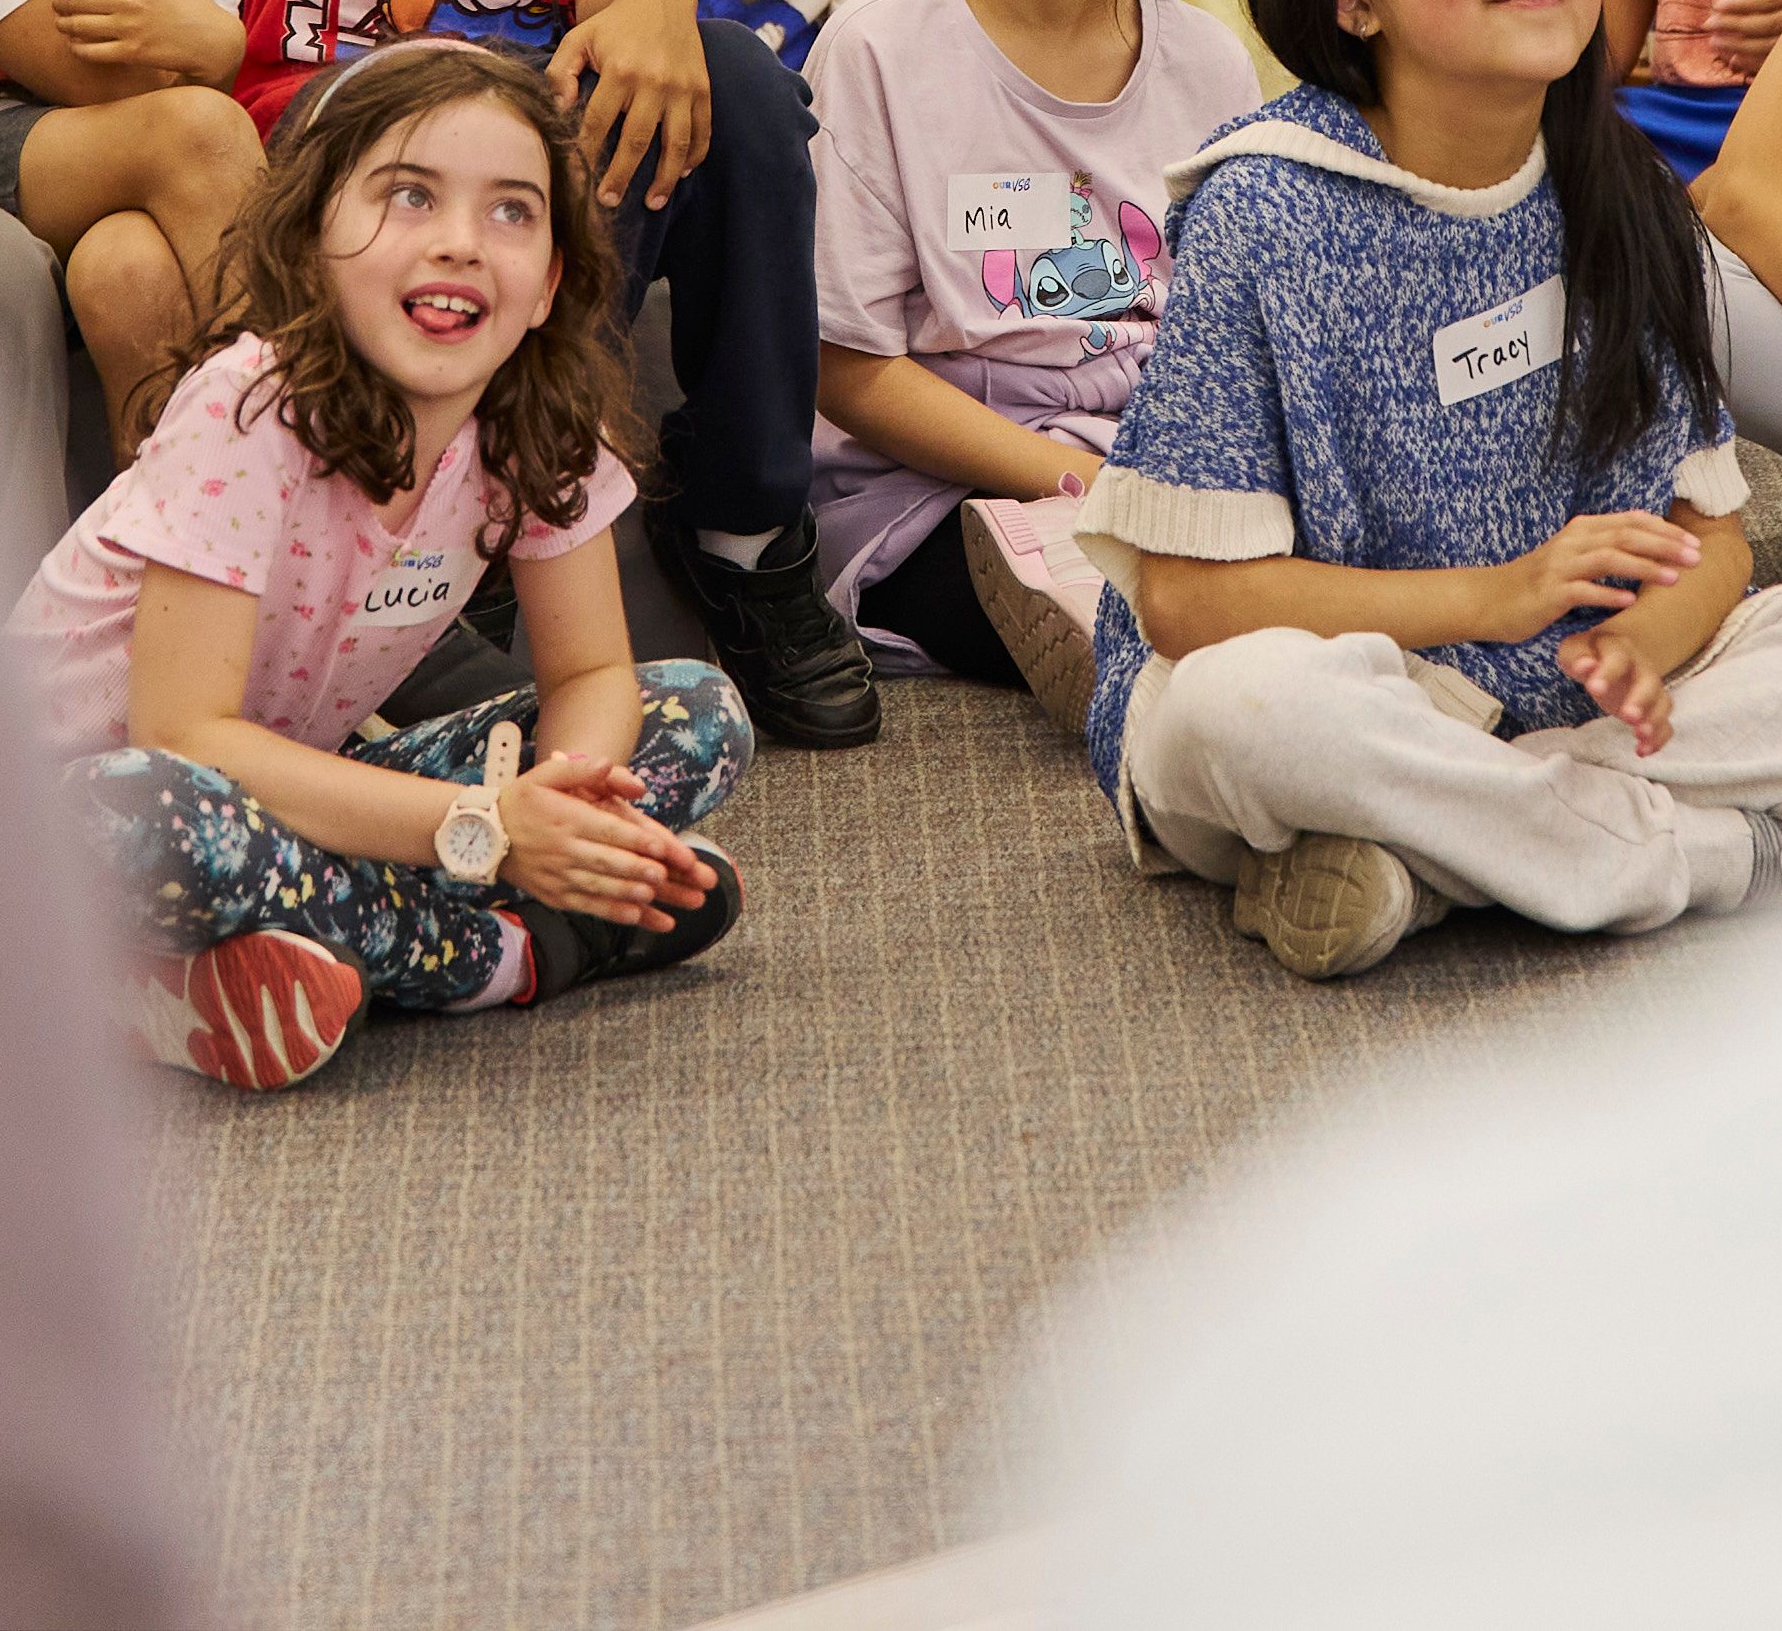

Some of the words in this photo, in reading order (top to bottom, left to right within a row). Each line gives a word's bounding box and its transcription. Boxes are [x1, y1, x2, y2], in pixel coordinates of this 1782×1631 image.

[965, 205, 1012, 234] Mia
[1452, 330, 1531, 380] Tracy
[364, 577, 450, 612] Lucia
